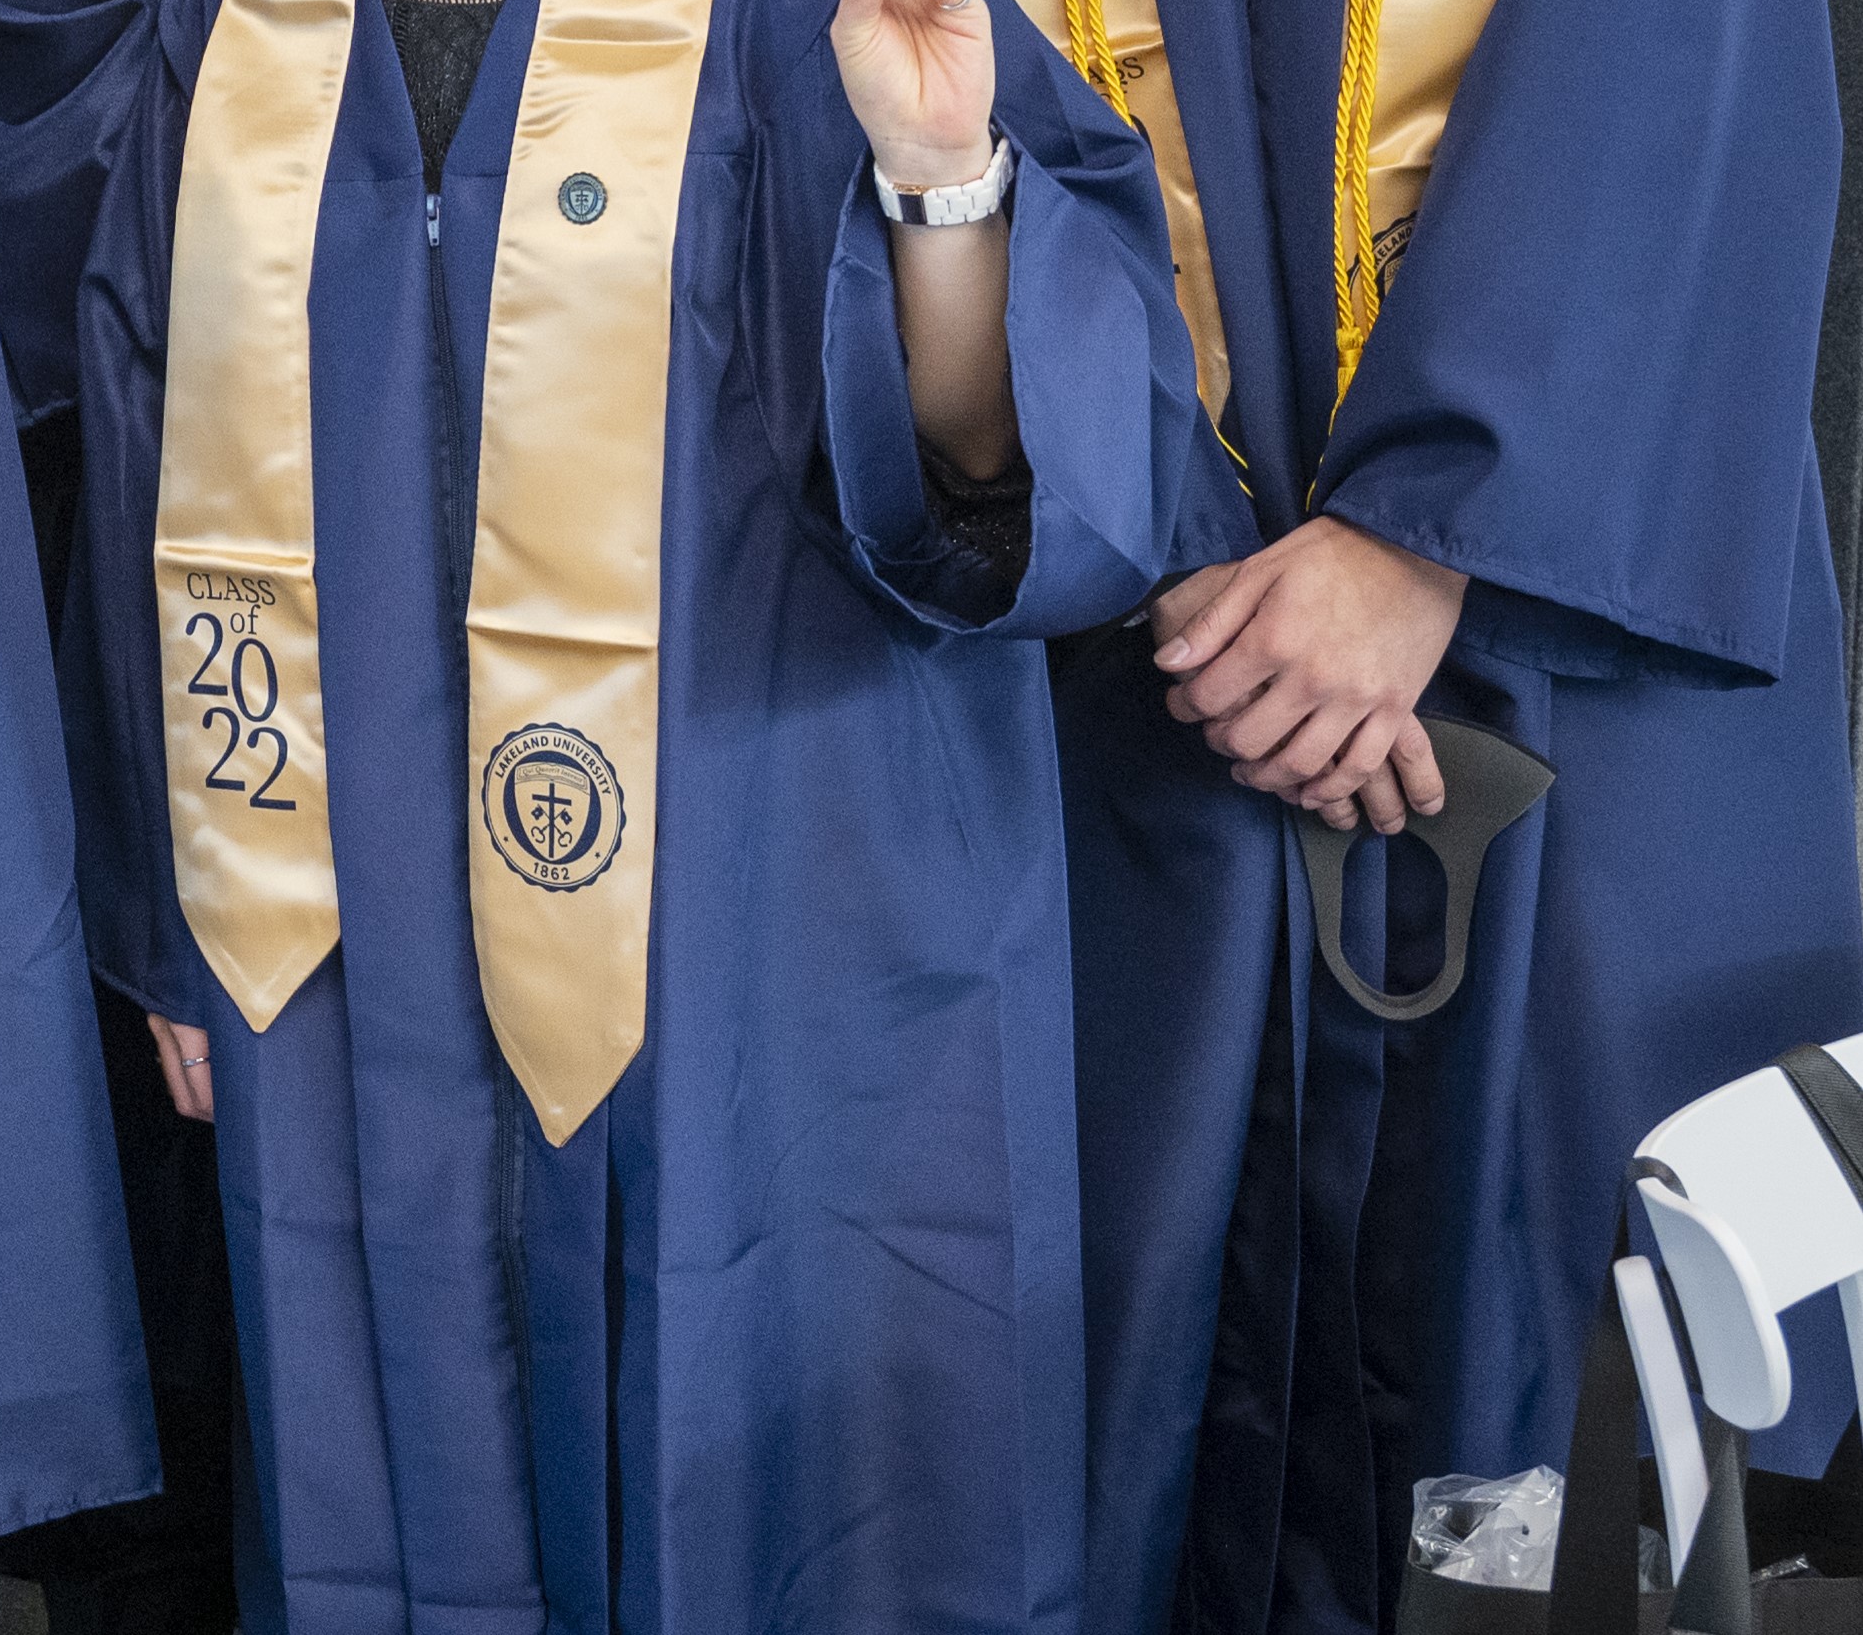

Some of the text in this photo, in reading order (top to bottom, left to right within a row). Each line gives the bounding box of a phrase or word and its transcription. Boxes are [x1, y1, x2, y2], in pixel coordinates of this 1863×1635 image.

[1374, 226, 1413, 269] KELAND
[186, 571, 276, 606] CLASS
[229, 603, 262, 636] of
[185, 611, 279, 723] 20
[202, 705, 297, 812] 22
[494, 735, 612, 796] LAKELAND UNIVERSITY
[532, 862, 570, 881] 1862
